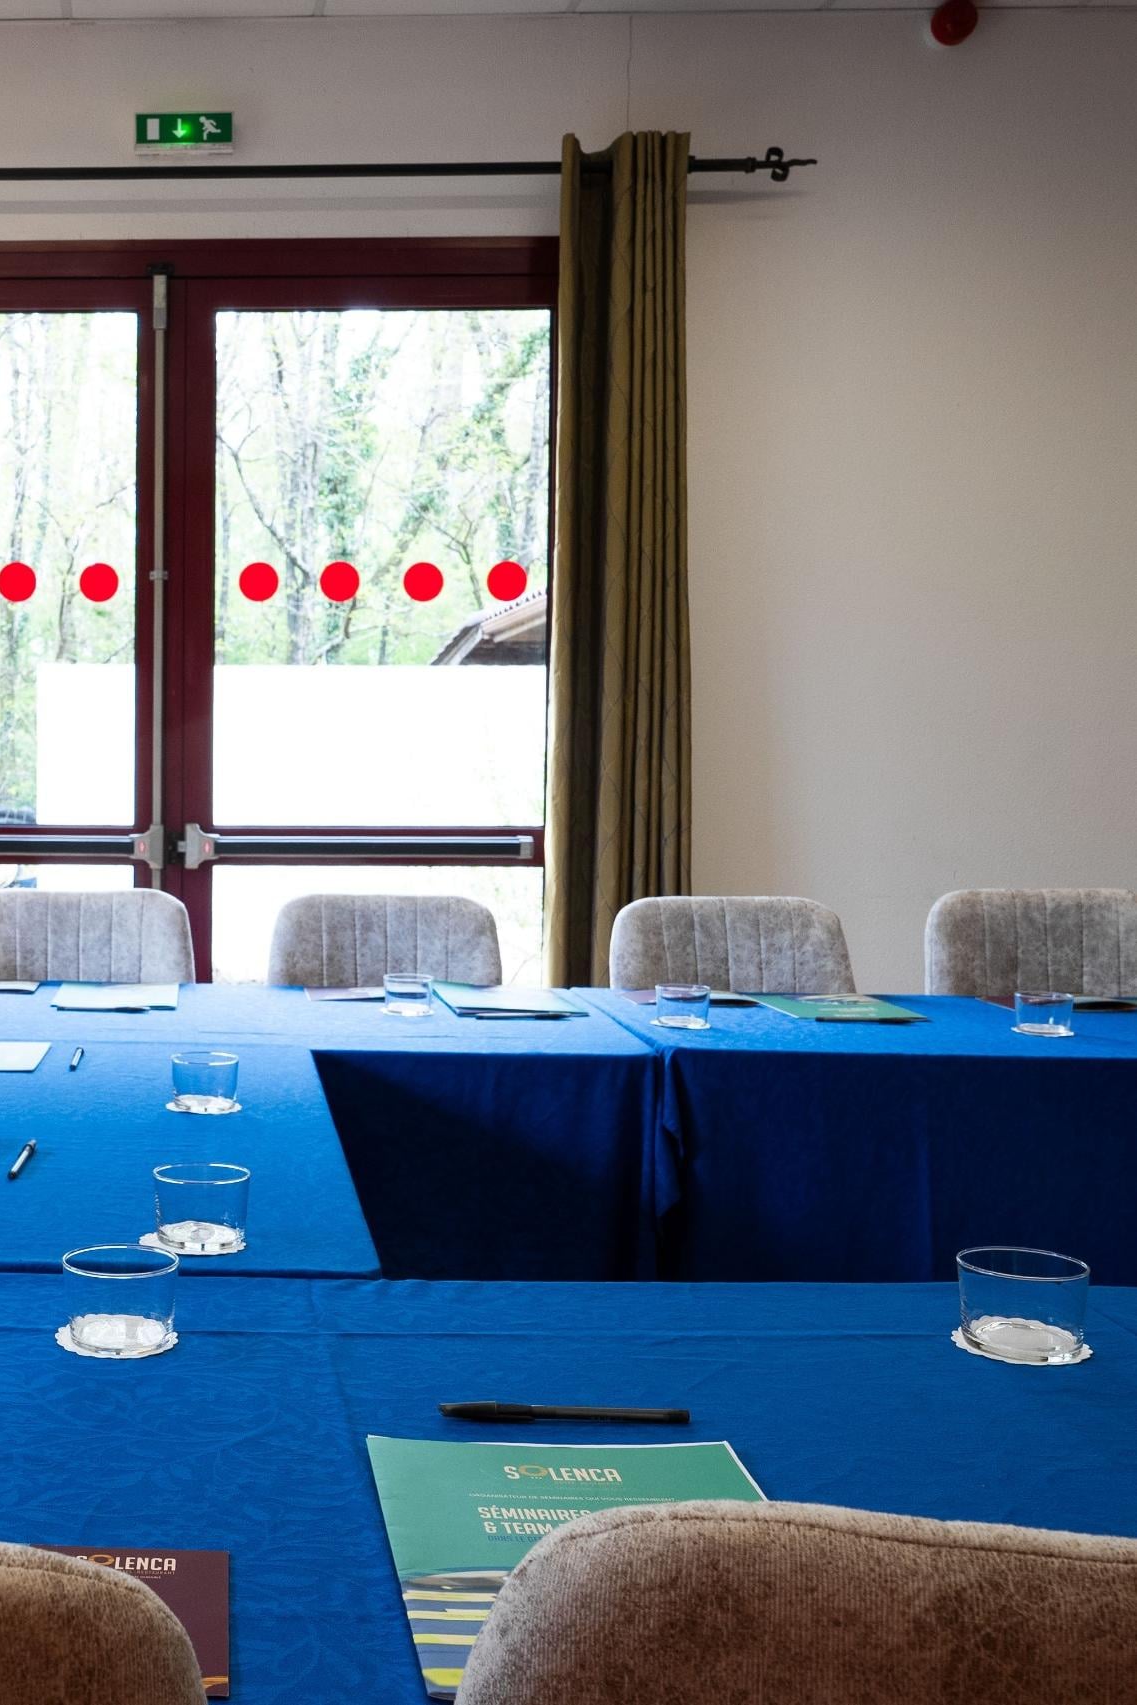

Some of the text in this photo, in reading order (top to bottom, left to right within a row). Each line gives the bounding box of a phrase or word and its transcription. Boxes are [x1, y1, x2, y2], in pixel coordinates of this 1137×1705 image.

[503, 1465, 623, 1482] SOLENCA
[484, 1521, 553, 1535] & TEAM
